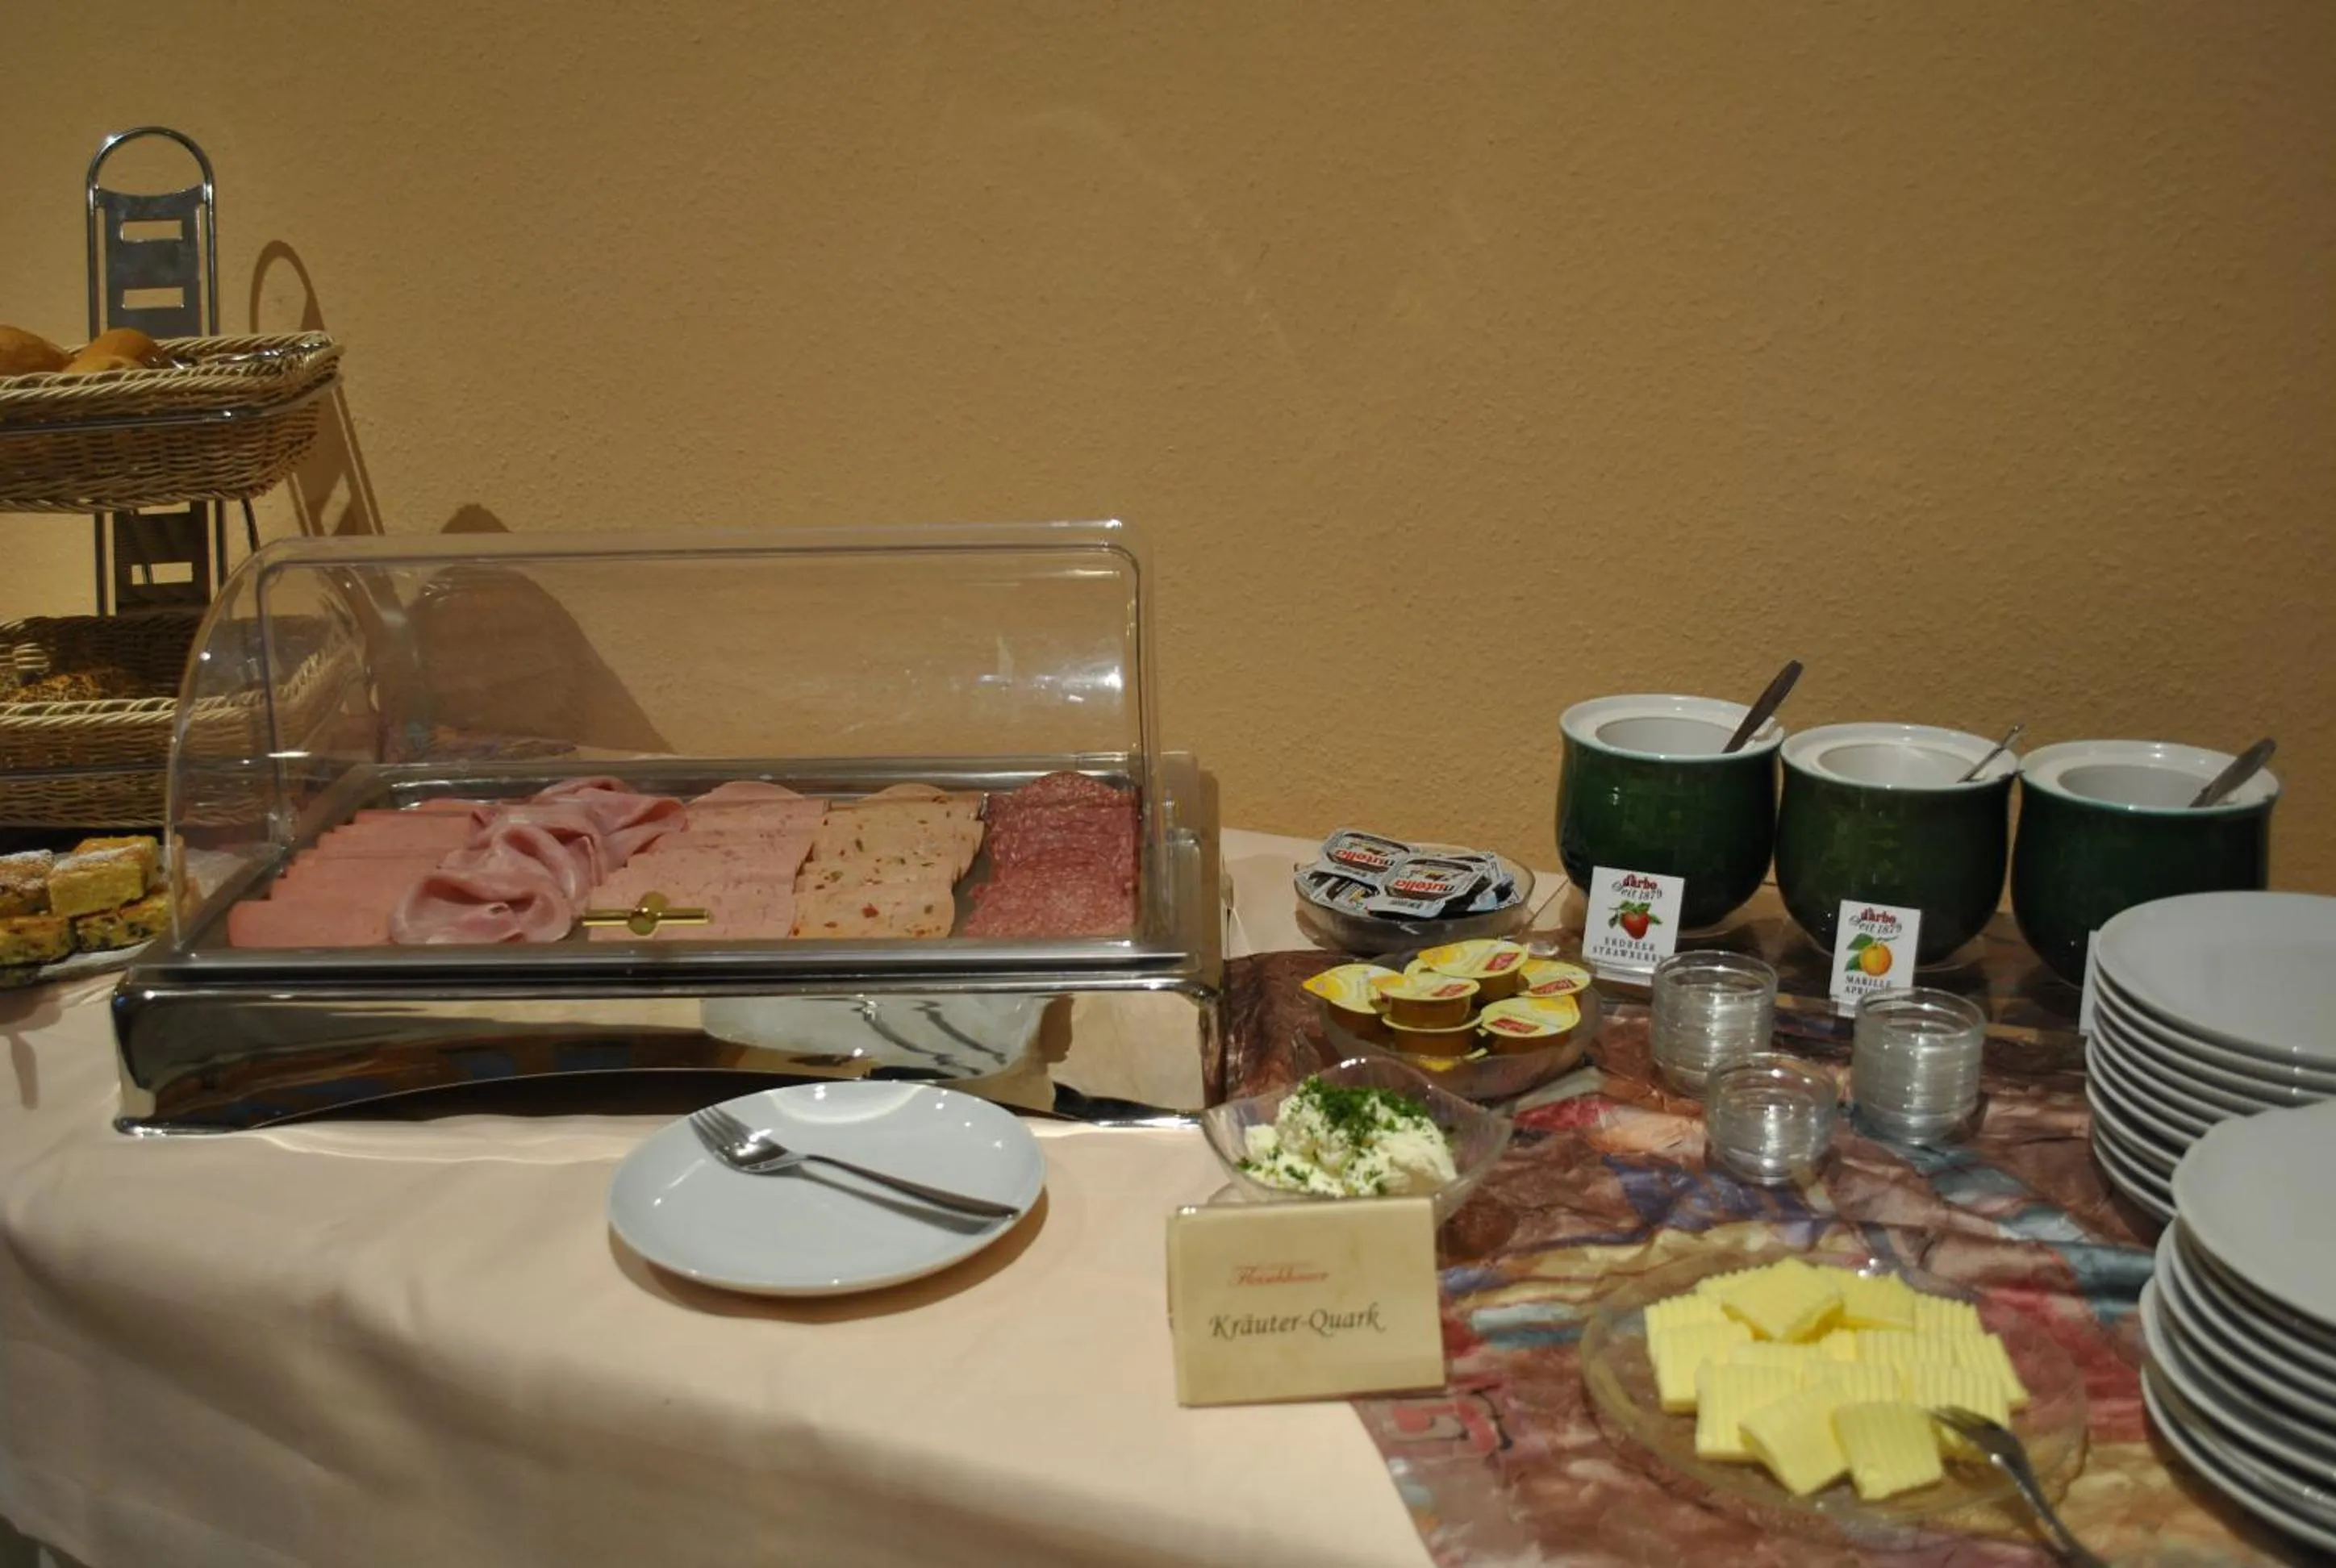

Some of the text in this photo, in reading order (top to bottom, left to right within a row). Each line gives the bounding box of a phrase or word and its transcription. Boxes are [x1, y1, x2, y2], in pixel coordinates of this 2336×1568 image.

[1333, 849, 1395, 866] nutella
[1394, 879, 1455, 890] nutella
[1208, 1301, 1387, 1341] Kräuter-Quark
